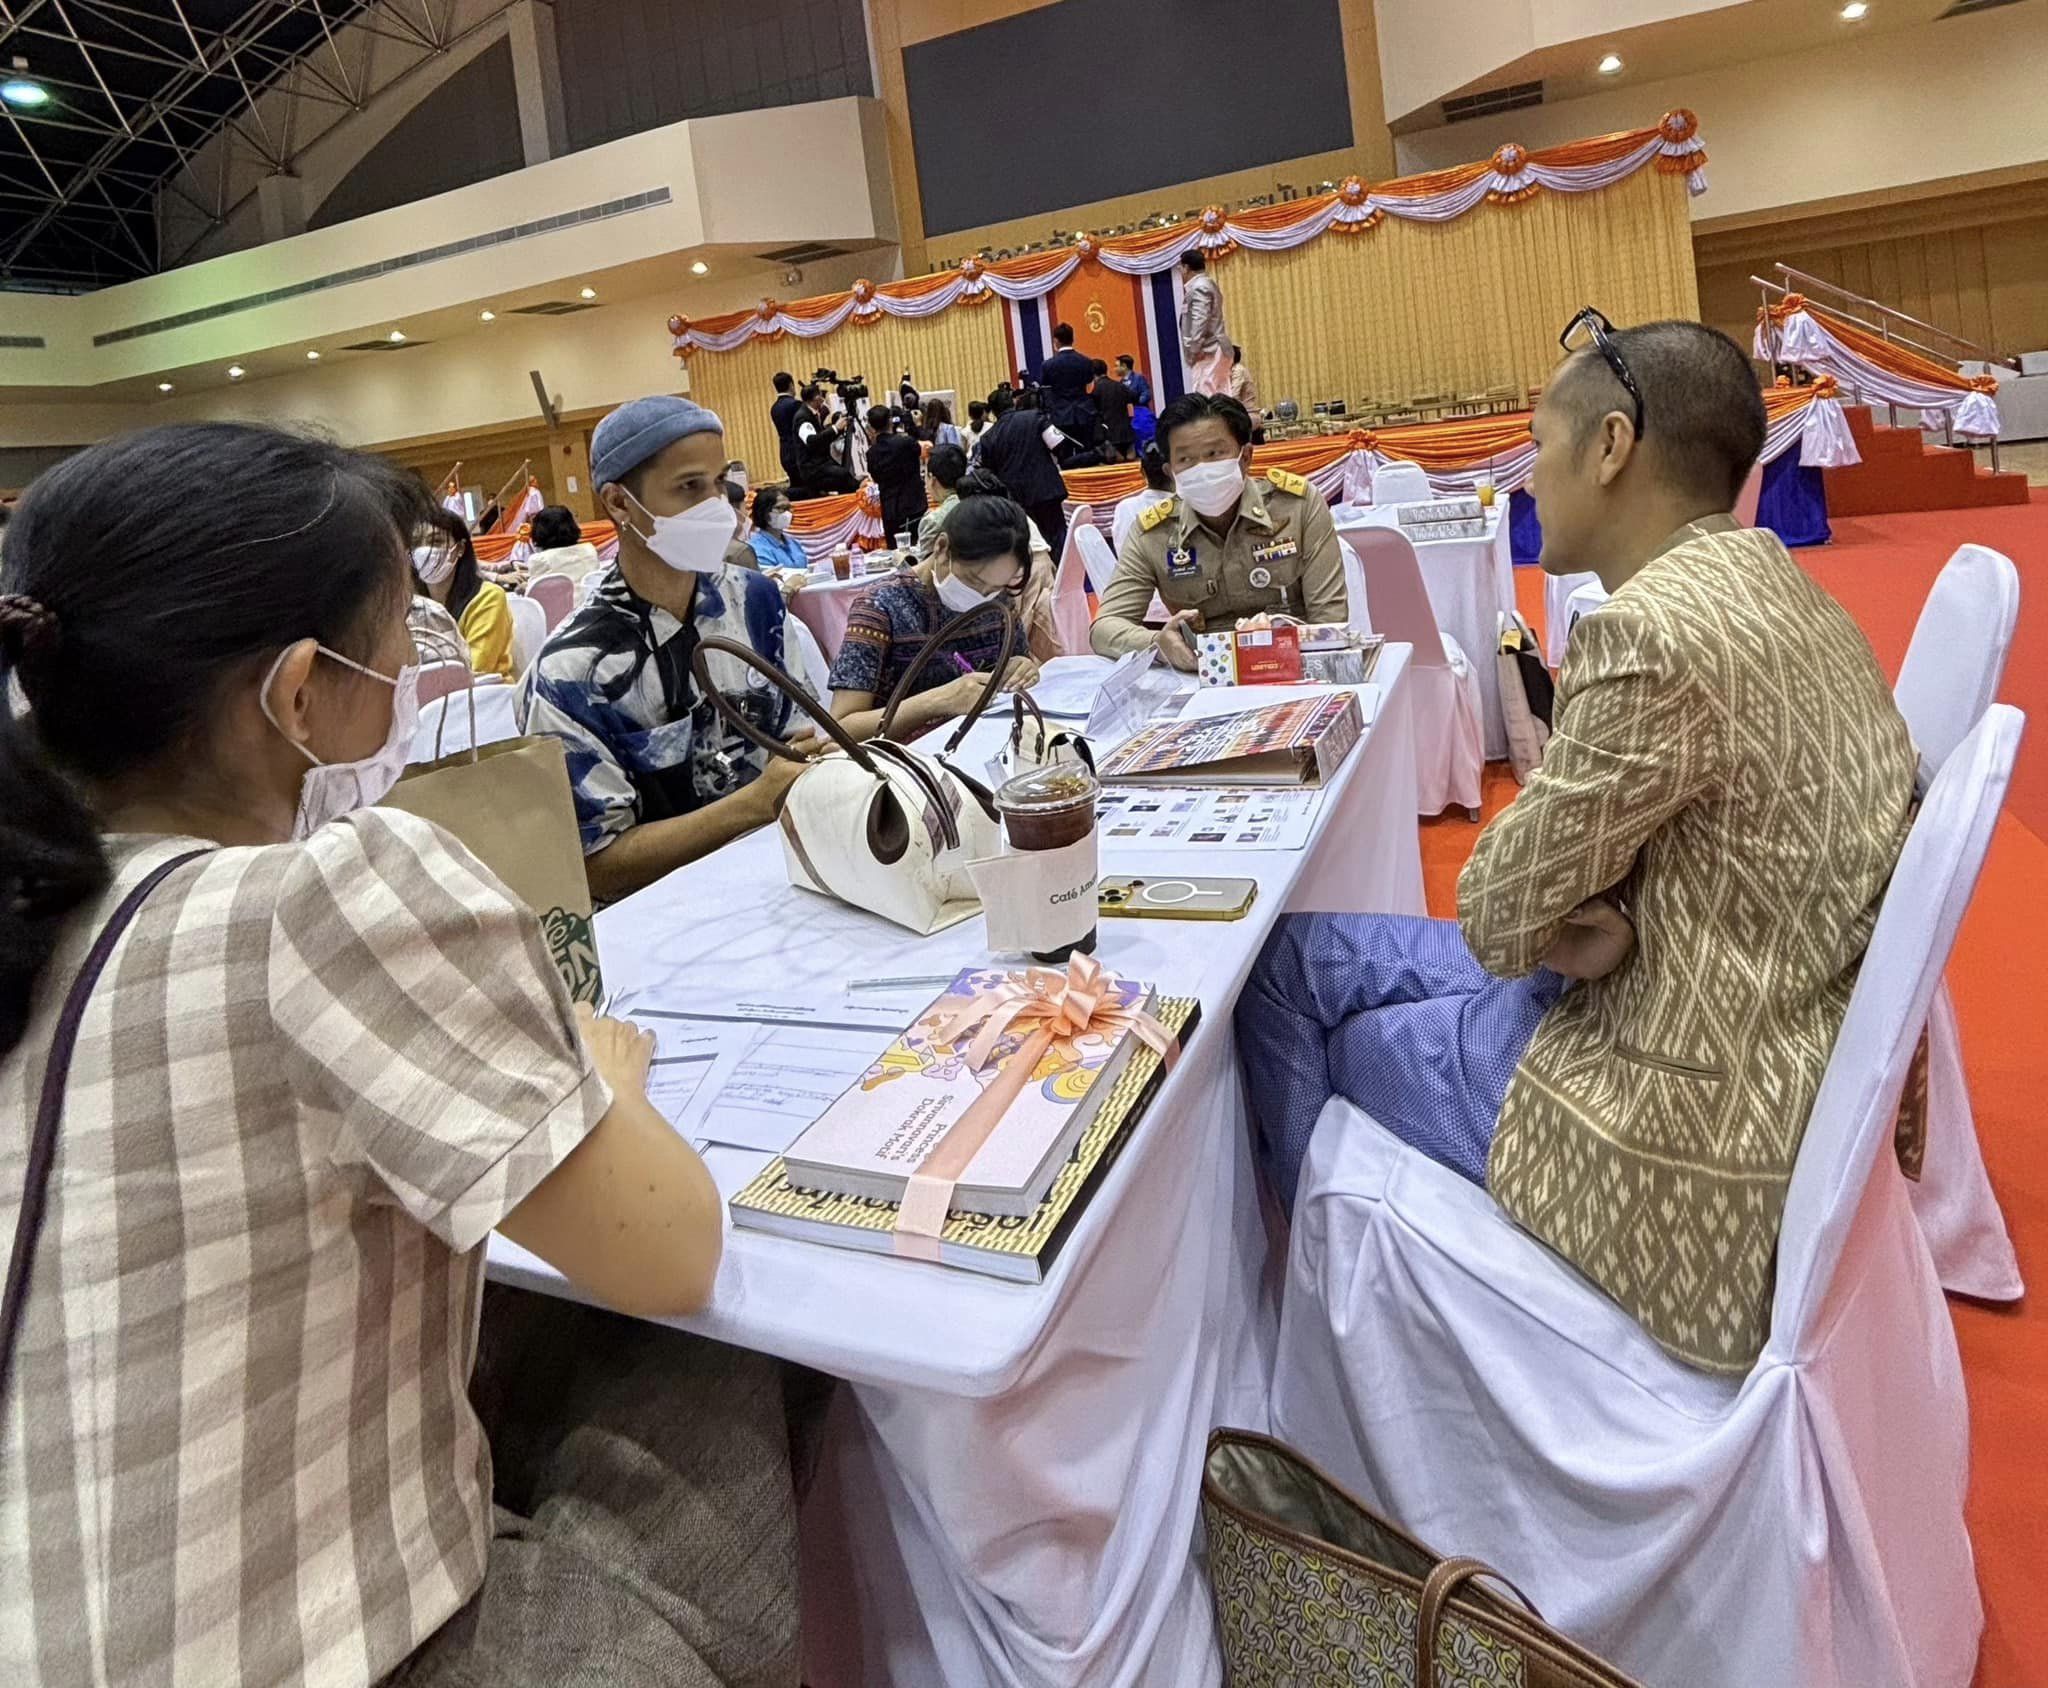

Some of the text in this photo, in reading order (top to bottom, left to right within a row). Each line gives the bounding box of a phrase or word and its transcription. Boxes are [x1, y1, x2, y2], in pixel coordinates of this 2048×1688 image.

[1050, 888, 1078, 905] Café
[875, 1098, 935, 1160] Dokrak Motif
[890, 1094, 954, 1161] Sirivannavari's
[907, 1123, 947, 1163] Princess
